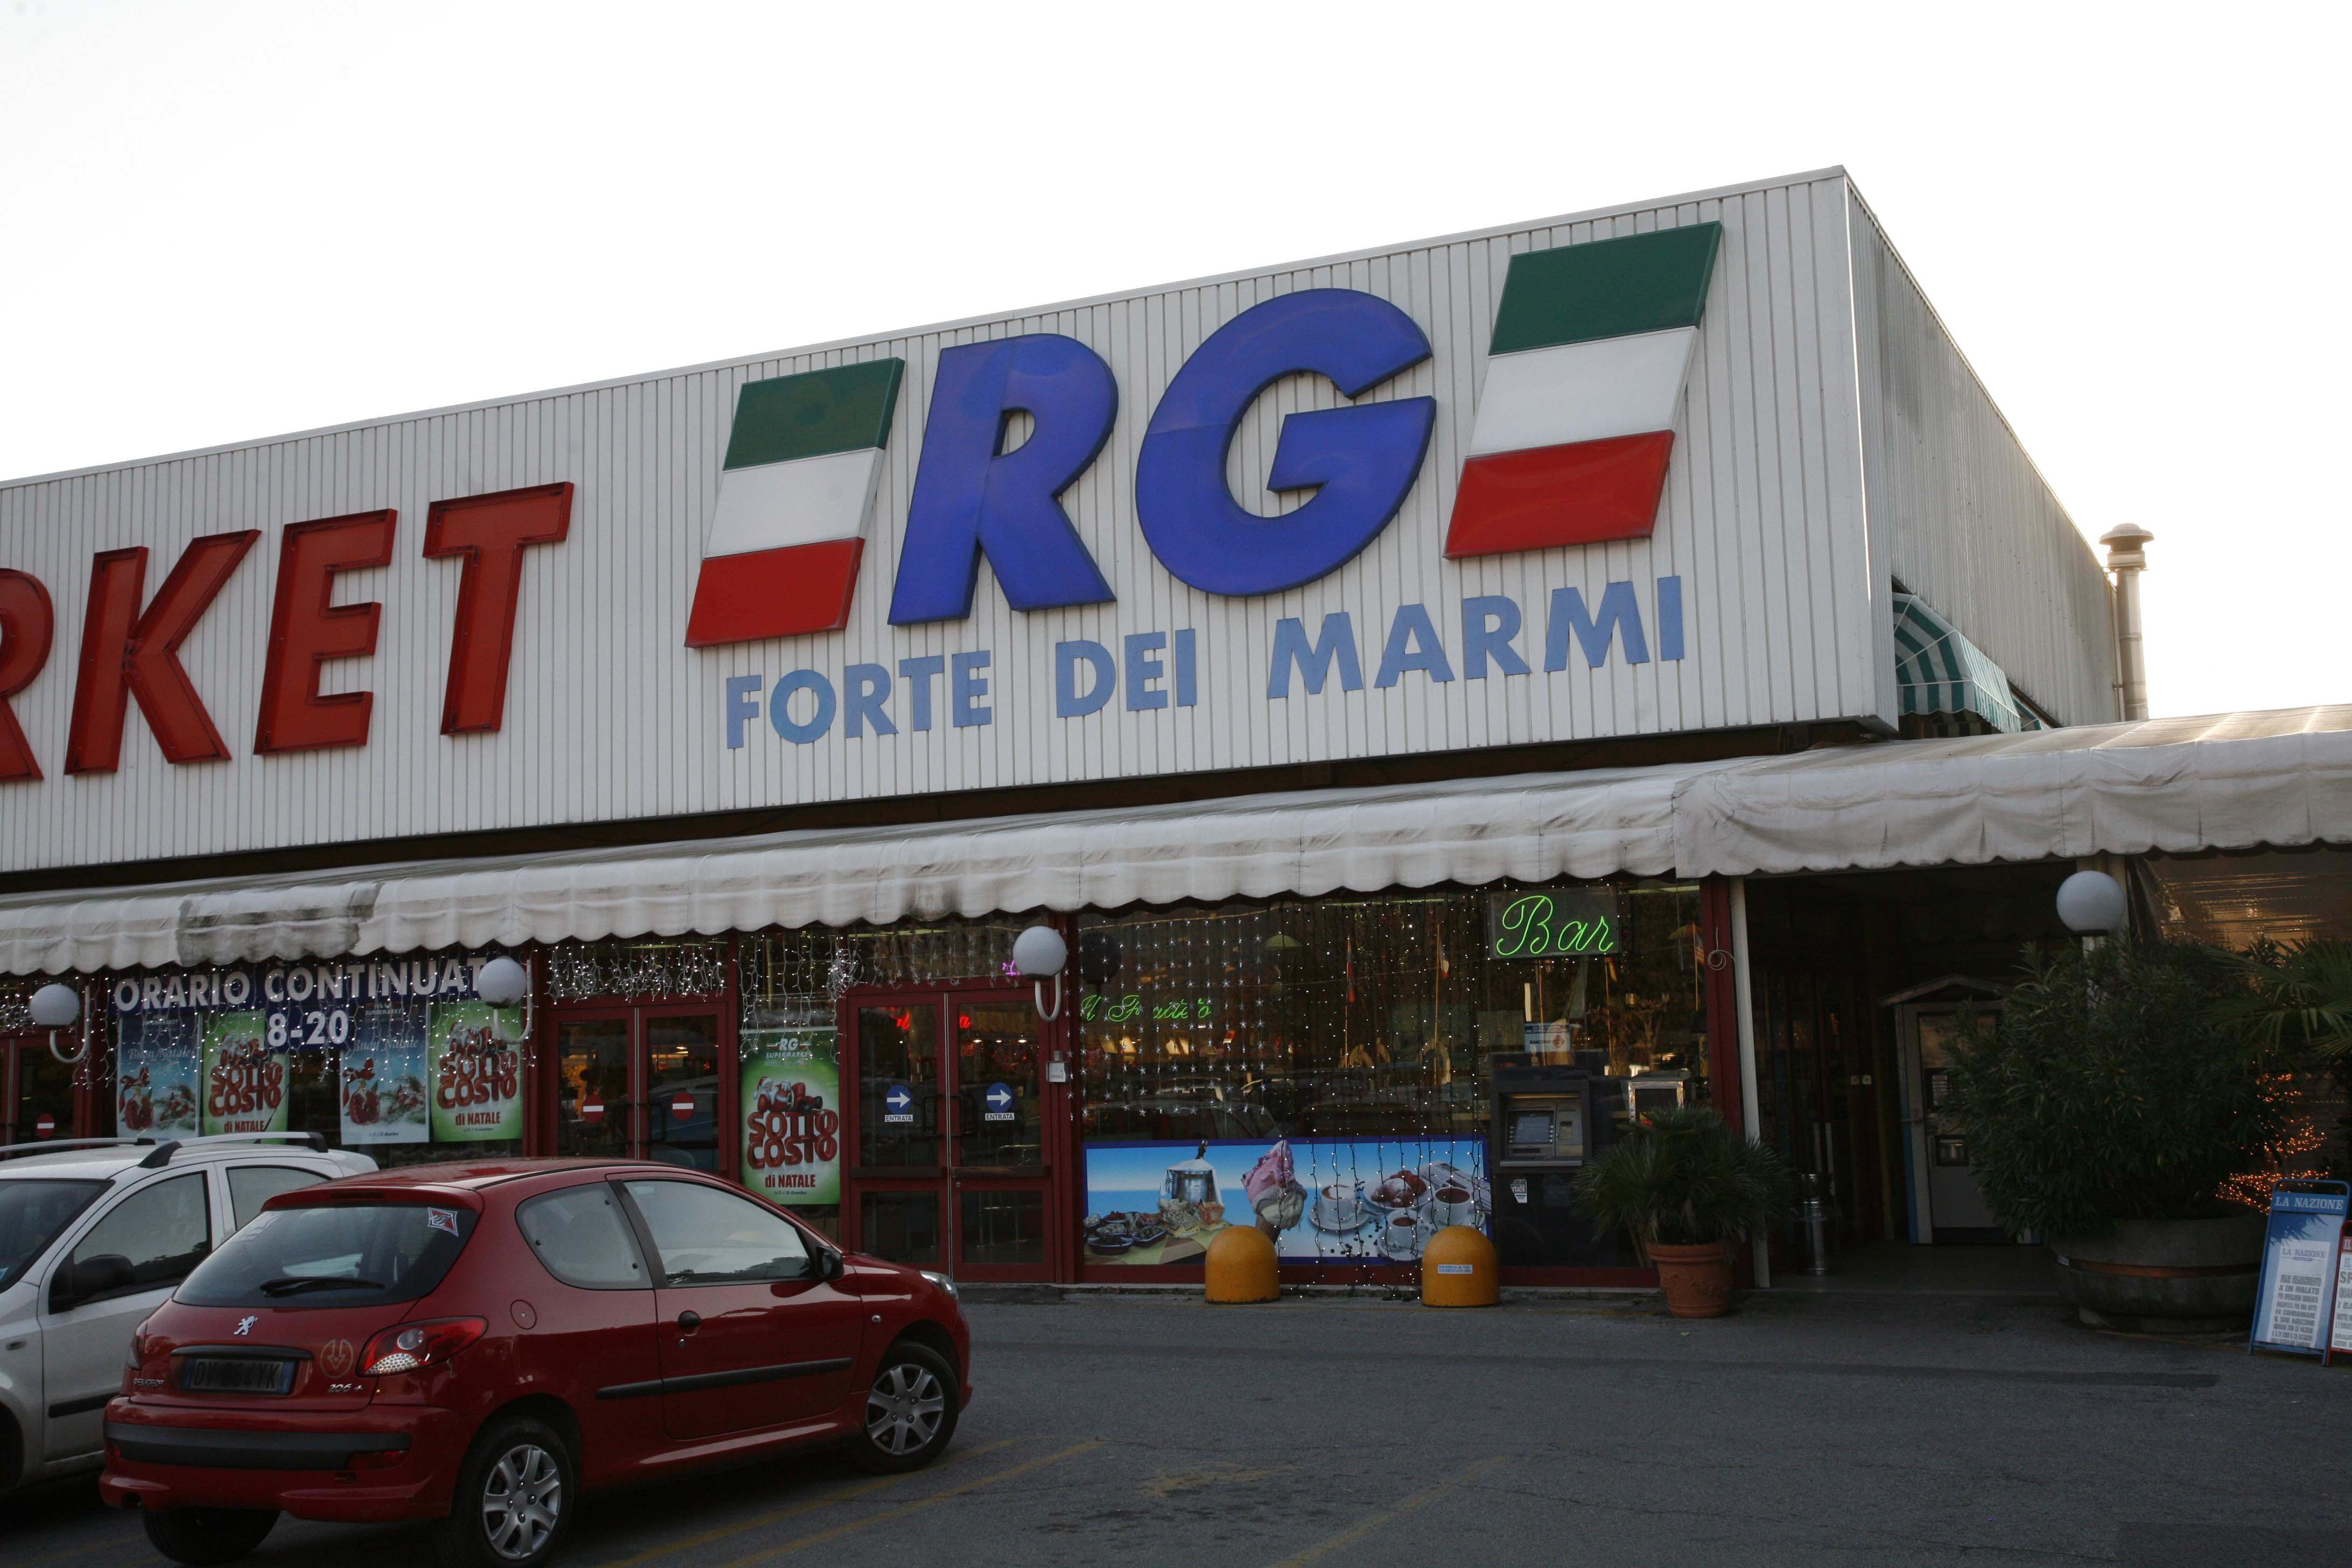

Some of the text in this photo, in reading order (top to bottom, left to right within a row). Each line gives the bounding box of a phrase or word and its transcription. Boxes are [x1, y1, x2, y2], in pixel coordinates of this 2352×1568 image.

[887, 288, 1436, 626] RG
[726, 575, 1682, 749] FORTE DEI MARMI
[1496, 895, 1614, 956] Bar
[114, 957, 487, 1012] ORARIO CONTINUAT
[268, 1010, 348, 1047] 8-20
[779, 1038, 799, 1051] RG
[211, 1062, 283, 1092] SOTTO
[439, 1051, 517, 1083] SOTTO
[209, 1084, 282, 1116] COSTO
[437, 1074, 517, 1109] COSTO
[225, 1120, 264, 1133] di NATALE
[456, 1112, 500, 1125] di NATALE
[747, 1109, 838, 1142] SOTTO
[746, 1134, 838, 1169] COSTO
[765, 1174, 815, 1188] di NATALE
[2275, 1196, 2343, 1210] LA NAZIONE
[2294, 1249, 2326, 1258] NAZIONE
[2295, 1286, 2320, 1295] MALATO
[327, 1383, 352, 1393] 206
